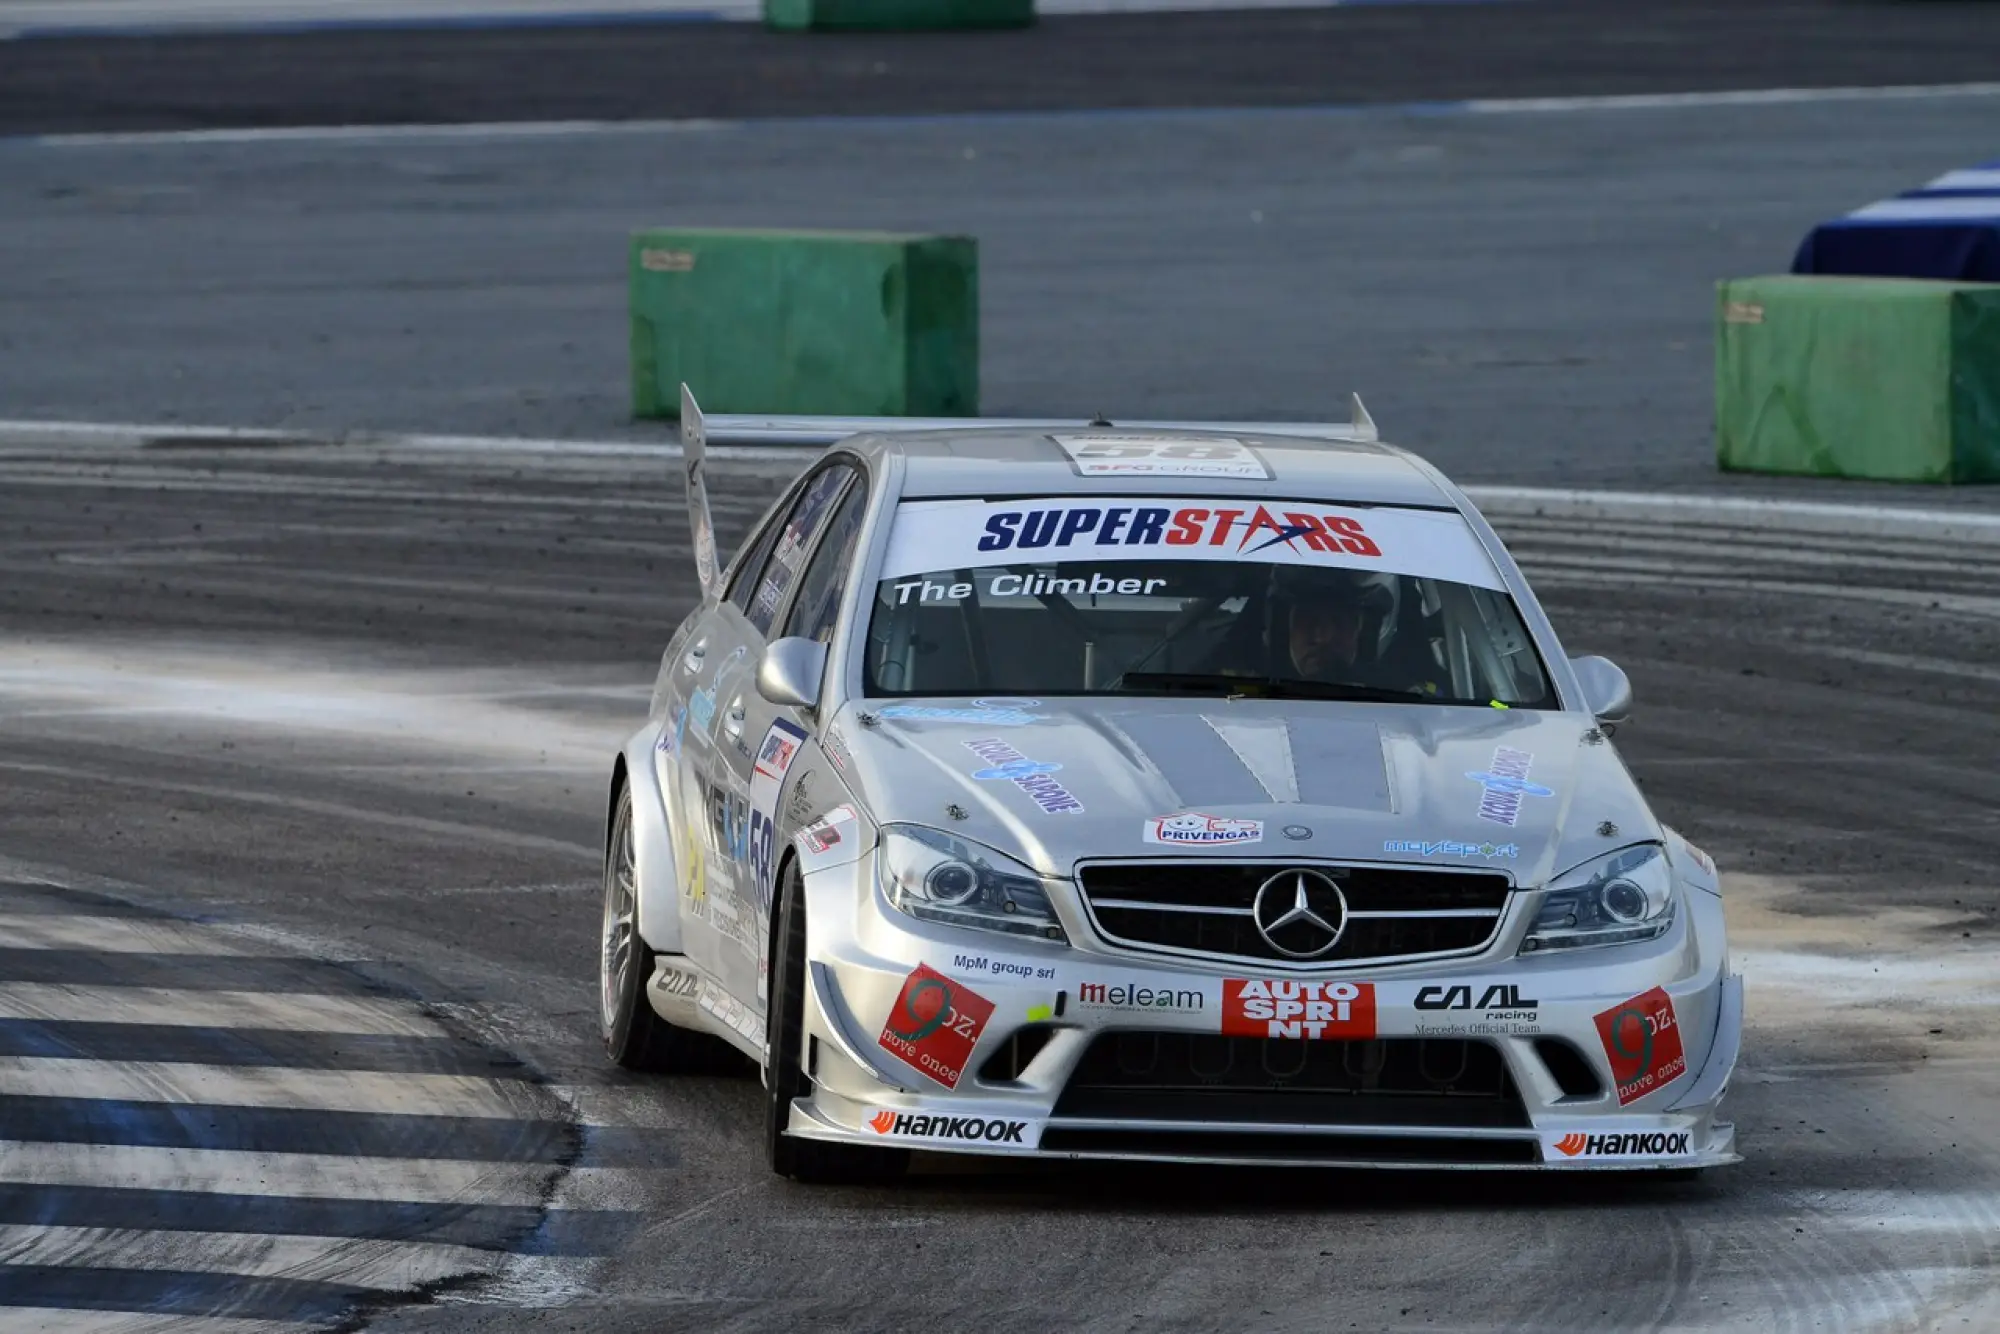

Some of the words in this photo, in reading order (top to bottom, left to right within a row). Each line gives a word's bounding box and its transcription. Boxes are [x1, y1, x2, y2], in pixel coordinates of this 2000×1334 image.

[1160, 464, 1262, 474] GROUP
[978, 504, 1382, 557] SUPERSTARS
[895, 580, 972, 605] The
[990, 573, 1167, 596] Climber
[954, 955, 988, 970] MpM
[992, 961, 1034, 979] group
[1037, 967, 1056, 980] srl
[1080, 982, 1204, 1009] meleam
[1238, 980, 1360, 1000] AUTO
[1243, 1000, 1351, 1021] SPRI
[1486, 1010, 1538, 1022] racing
[1268, 1020, 1328, 1040] NT
[1415, 1023, 1467, 1035] Mercedes
[1470, 1022, 1509, 1035] Official
[1511, 1022, 1541, 1033] Team
[882, 1027, 917, 1057] nove
[920, 1053, 960, 1082] once
[1618, 1073, 1654, 1099] nove
